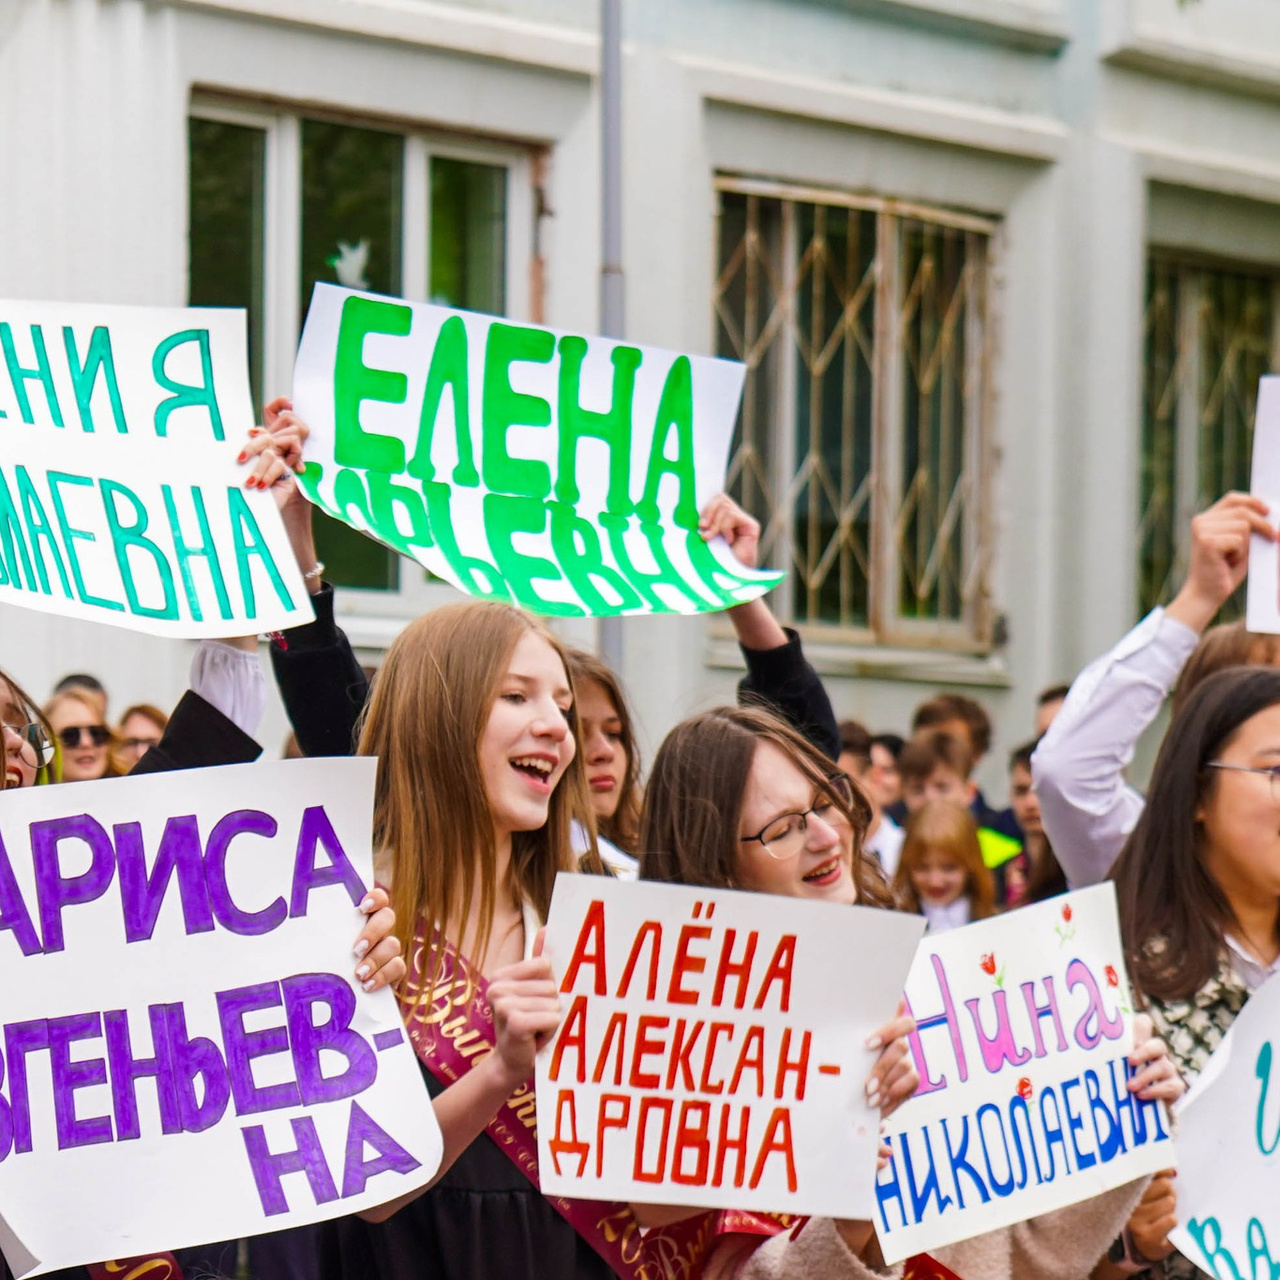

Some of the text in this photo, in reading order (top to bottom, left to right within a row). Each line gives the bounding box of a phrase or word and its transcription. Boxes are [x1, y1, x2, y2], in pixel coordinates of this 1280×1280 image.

[333, 295, 702, 529] ЕЛЕНА
[559, 899, 797, 1013] АЛЁНА
[548, 995, 842, 1101] АЛЕКСАН-
[903, 952, 1125, 1099] Нина
[240, 1099, 423, 1218] НА
[548, 1088, 798, 1193] ДРОВНА
